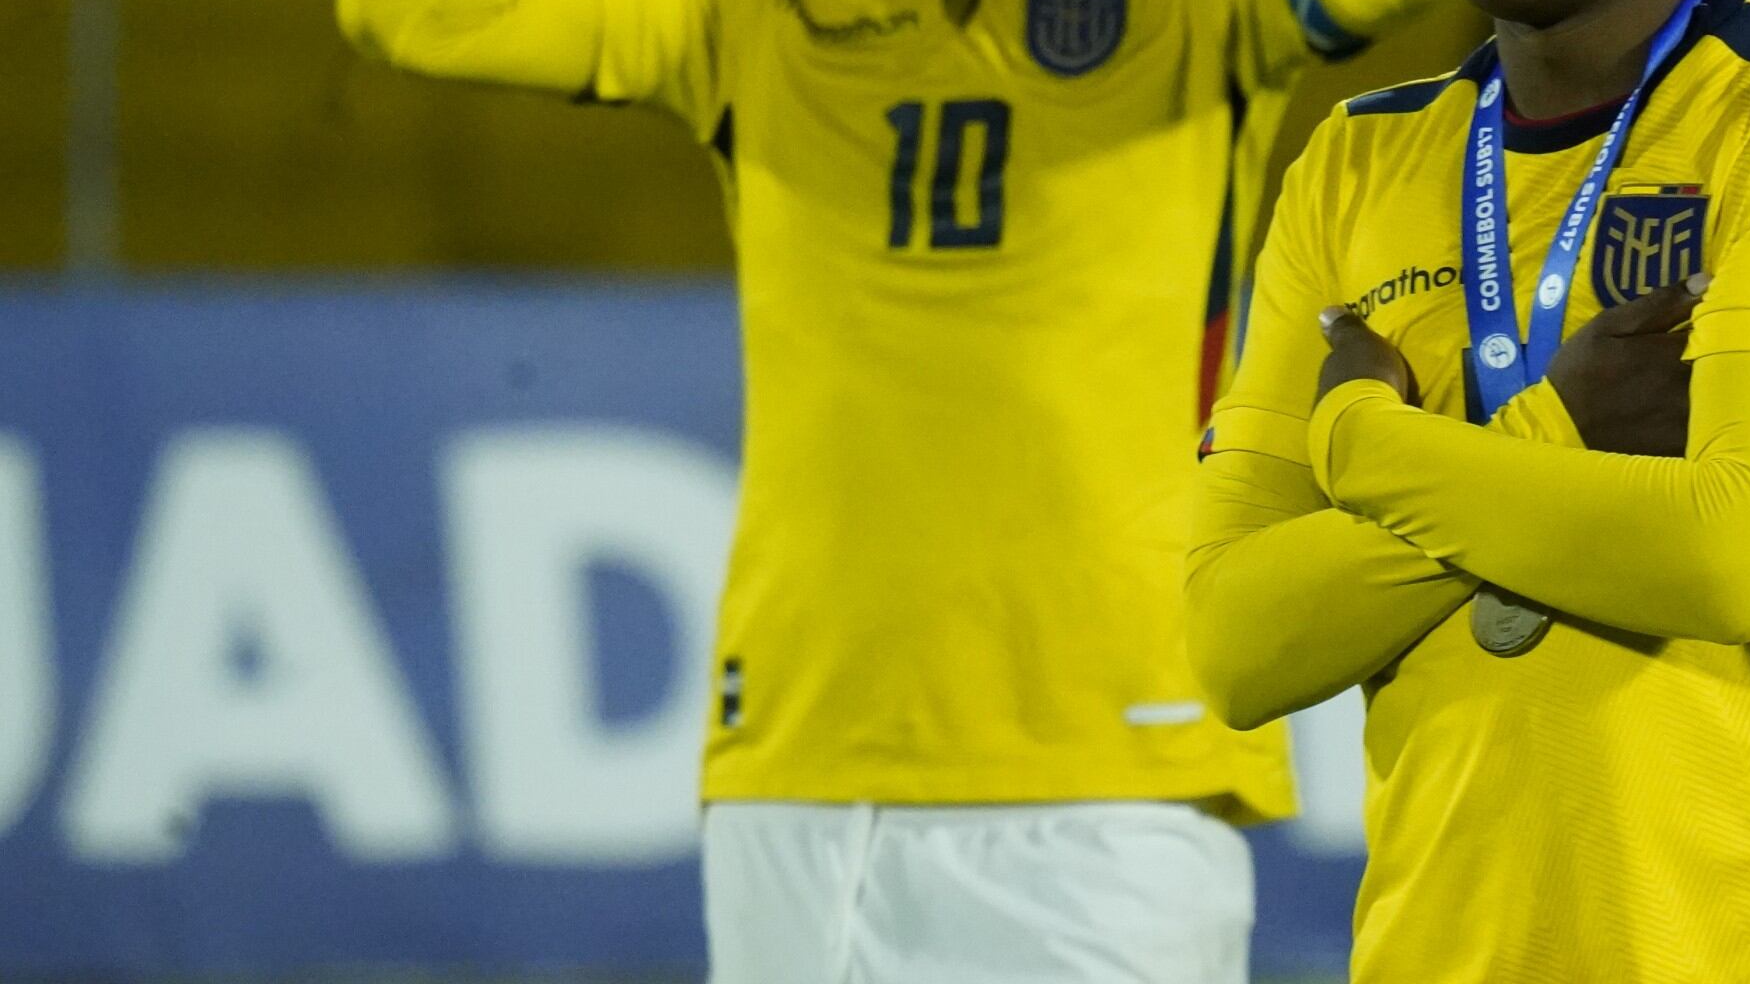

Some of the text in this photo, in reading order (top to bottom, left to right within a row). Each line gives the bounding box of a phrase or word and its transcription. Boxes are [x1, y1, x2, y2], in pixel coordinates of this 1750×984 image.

[884, 99, 1013, 249] 10
[1475, 126, 1501, 312] CONMEBOL SUB17
[0, 424, 743, 866] AD
